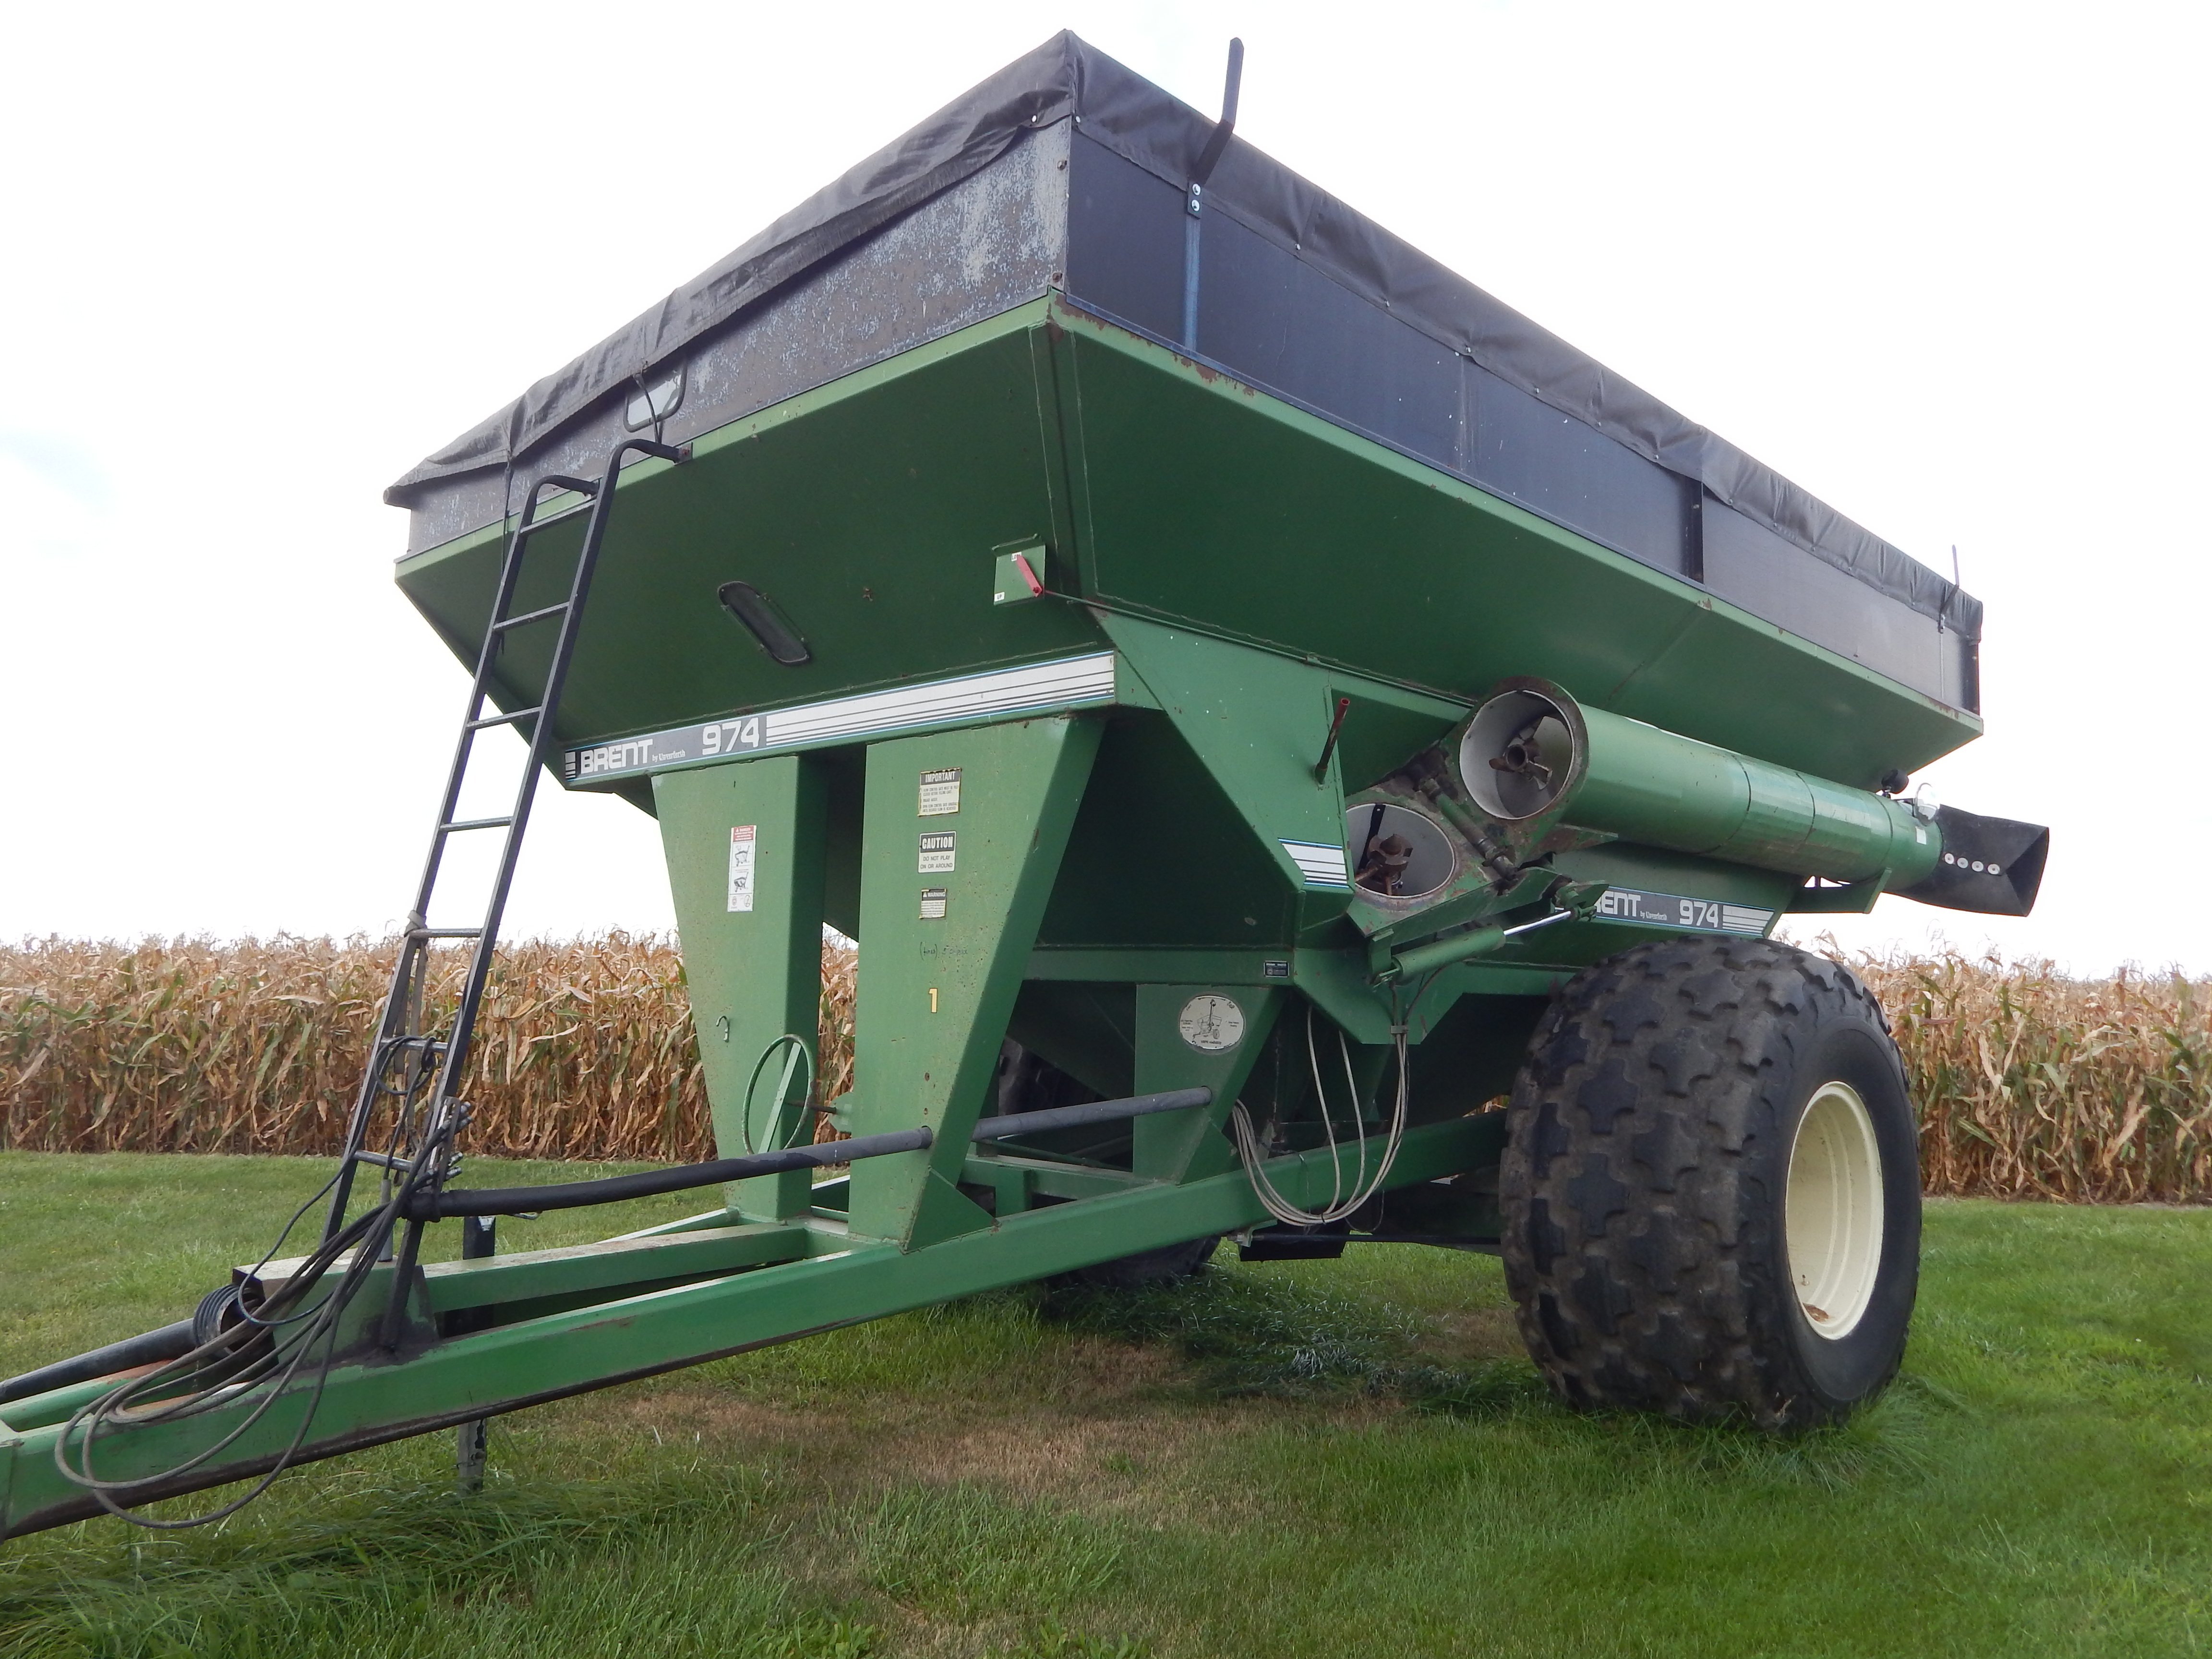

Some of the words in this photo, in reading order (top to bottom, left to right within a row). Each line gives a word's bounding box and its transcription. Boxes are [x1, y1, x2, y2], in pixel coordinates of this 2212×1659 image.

[702, 717, 759, 755] 974
[580, 739, 653, 774] BRENT
[925, 771, 956, 782] IMPORTANT
[922, 836, 953, 850] CAUTION
[1680, 900, 1718, 928] 974
[929, 988, 938, 1013] 1
